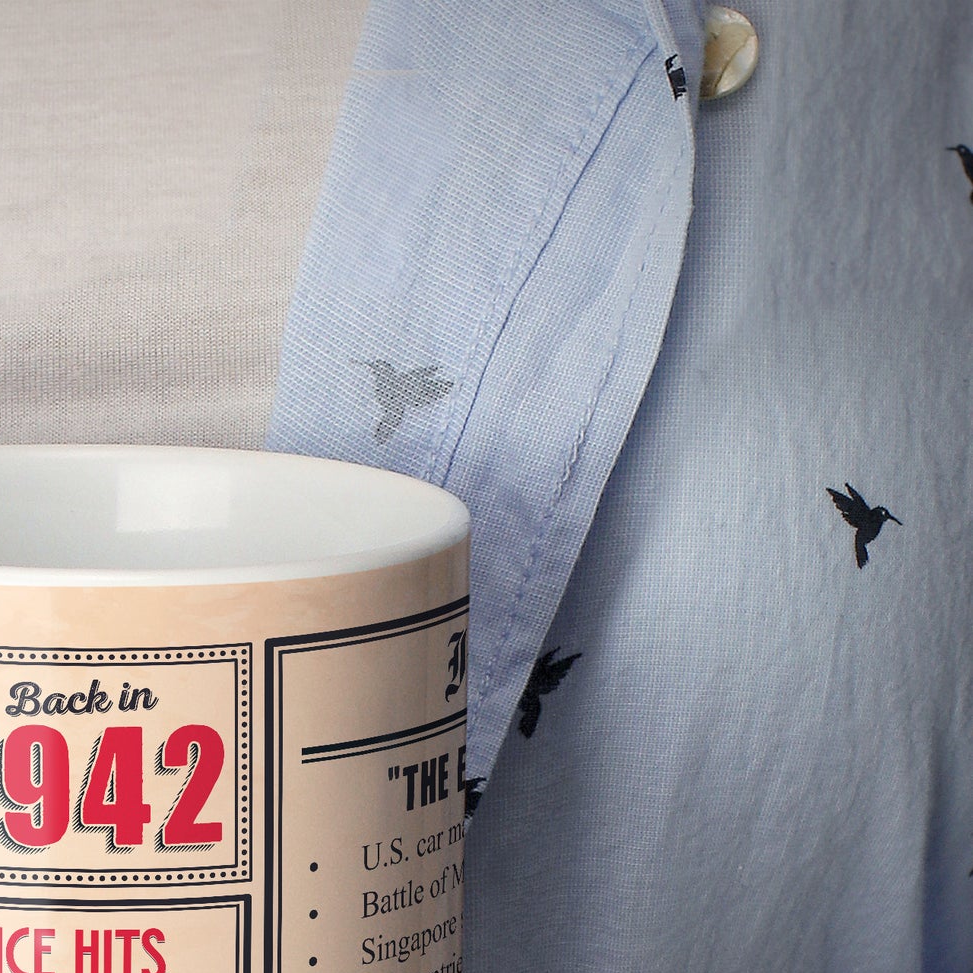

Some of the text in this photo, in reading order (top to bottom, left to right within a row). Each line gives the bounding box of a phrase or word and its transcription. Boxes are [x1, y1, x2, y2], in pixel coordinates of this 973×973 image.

[5, 679, 159, 717] Back in
[387, 752, 449, 812] "THE
[362, 837, 409, 871] U.S.
[416, 831, 444, 857] car
[361, 880, 425, 919] Battle
[429, 866, 450, 899] of
[361, 915, 457, 965] Singapore
